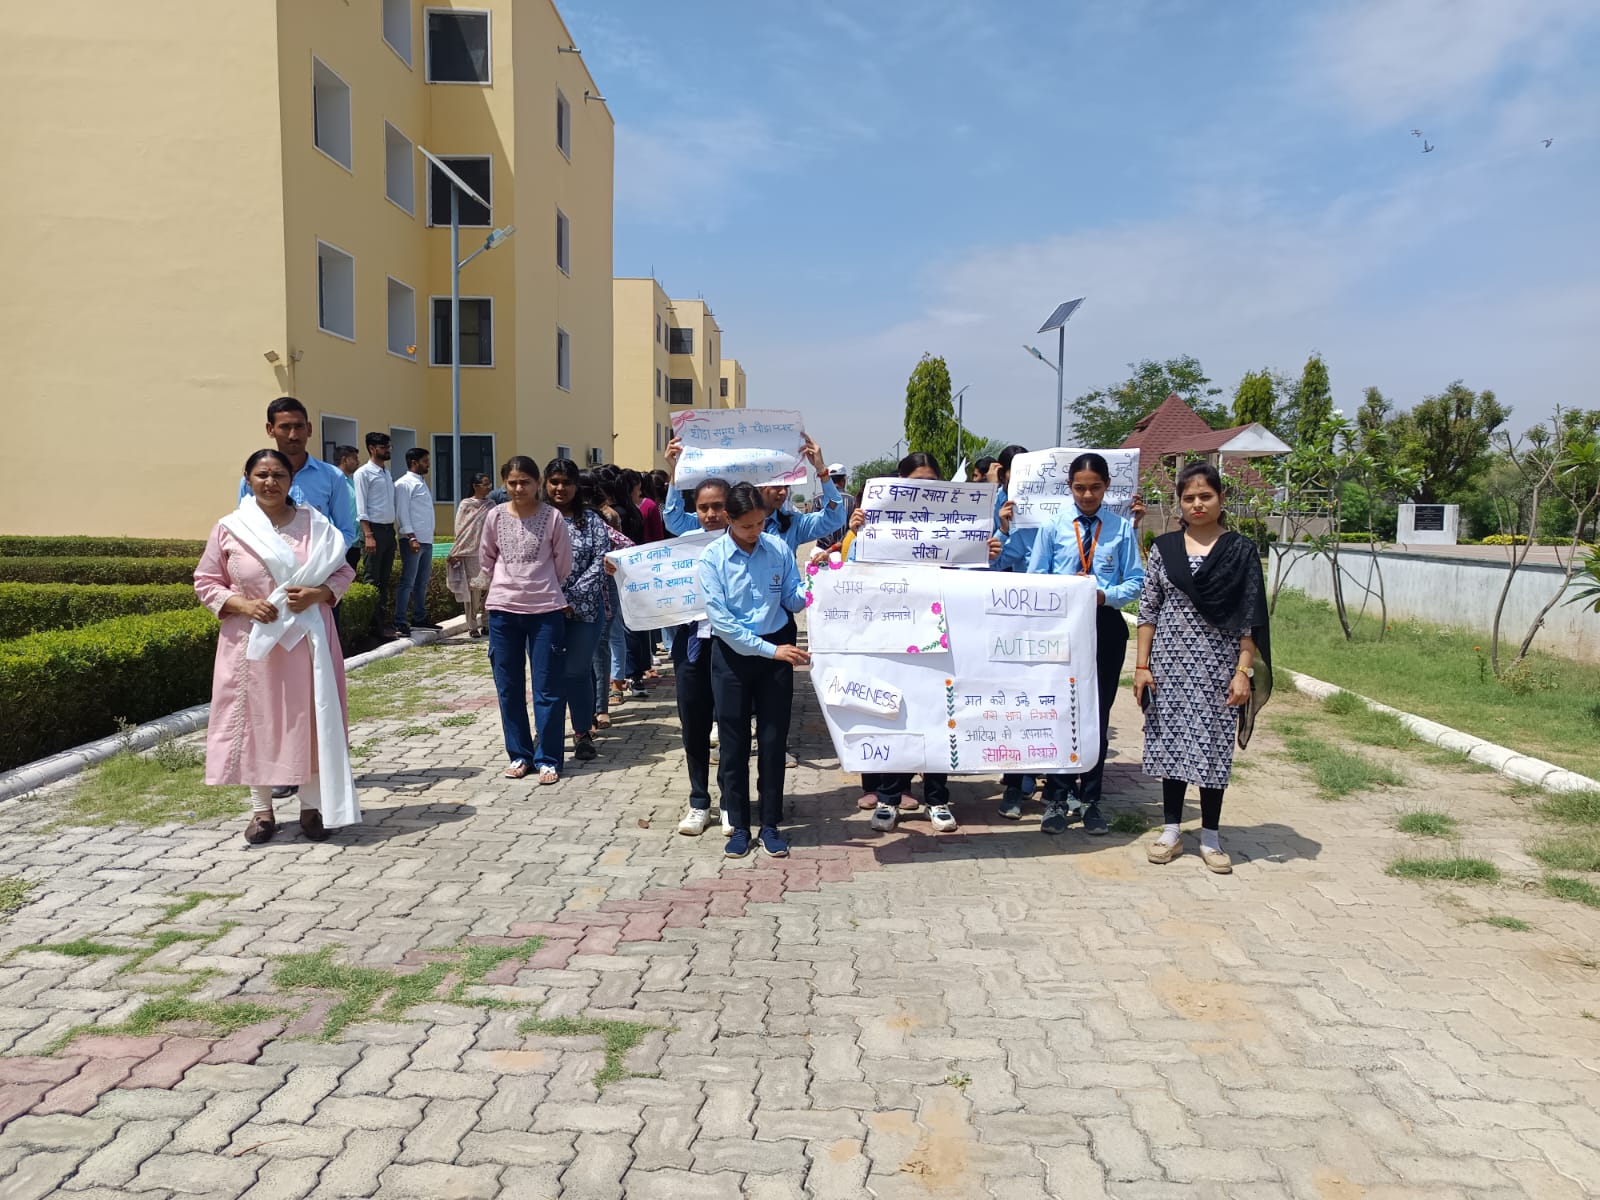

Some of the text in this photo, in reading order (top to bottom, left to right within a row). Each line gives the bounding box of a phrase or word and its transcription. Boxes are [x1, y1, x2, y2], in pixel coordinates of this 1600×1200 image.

[868, 485, 886, 499] हर
[889, 485, 920, 501] बच्चा
[922, 488, 948, 502] खास
[866, 526, 882, 540] को
[912, 543, 942, 560] सीखो
[992, 588, 1061, 611] WORLD
[863, 605, 873, 622] को
[995, 637, 1059, 656] AUTISM
[828, 676, 899, 709] AWARENESS
[965, 695, 982, 706] मत
[990, 690, 1006, 705] करो
[861, 742, 890, 760] DAY
